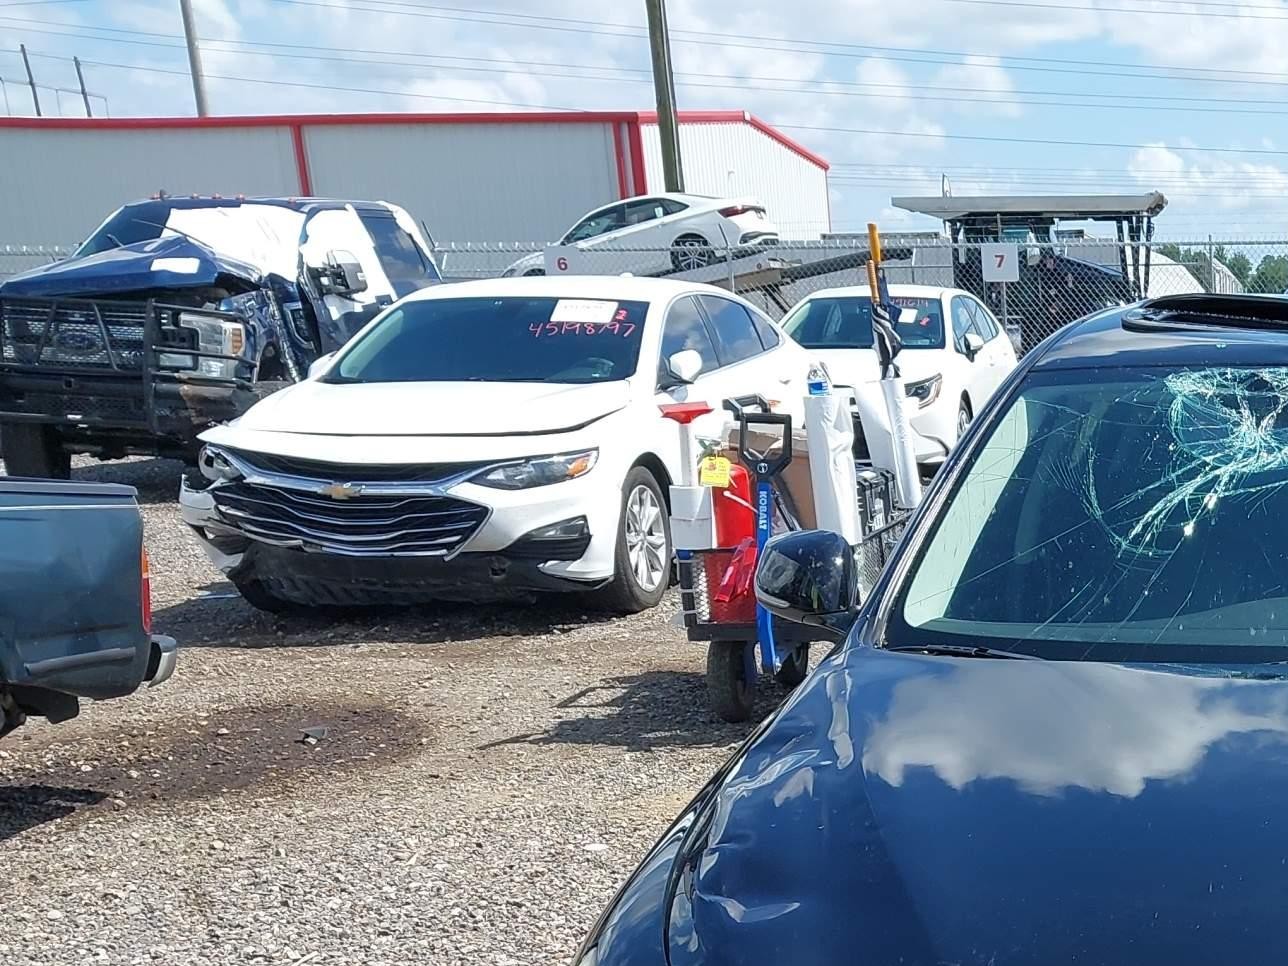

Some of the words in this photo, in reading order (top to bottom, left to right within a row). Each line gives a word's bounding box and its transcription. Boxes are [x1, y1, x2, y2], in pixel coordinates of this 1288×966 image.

[557, 257, 568, 271] 6
[994, 254, 1005, 268] 7
[759, 491, 768, 530] KOBALT
